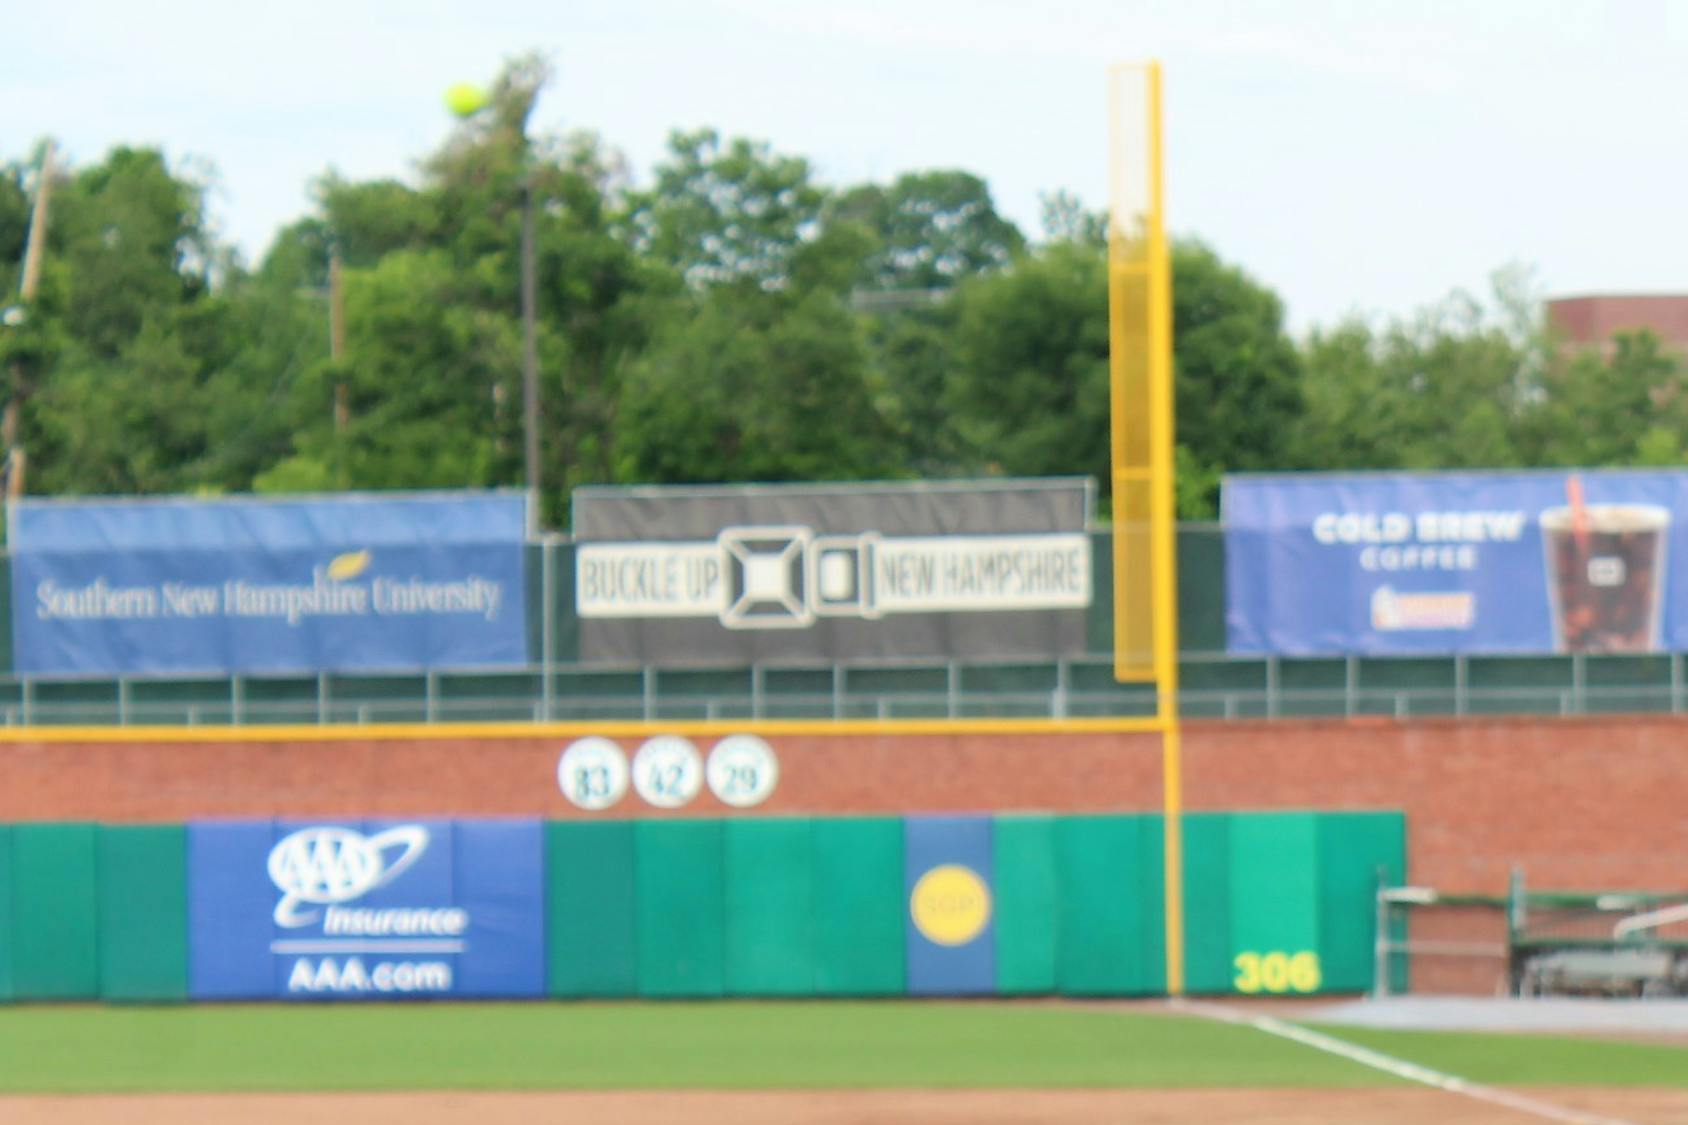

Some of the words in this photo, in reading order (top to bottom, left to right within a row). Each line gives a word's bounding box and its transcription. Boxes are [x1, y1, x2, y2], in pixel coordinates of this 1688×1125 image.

[1312, 513, 1411, 544] COLD
[1416, 511, 1525, 542] BREW
[584, 555, 680, 603] BUCKLE
[686, 555, 719, 602] UP
[879, 552, 937, 597] NEW
[944, 546, 1082, 597] HAMPSHIRE
[1359, 545, 1478, 571] COFFEE
[36, 575, 156, 620] Southern
[162, 580, 218, 618] New
[224, 564, 367, 626] Hampshire
[372, 574, 503, 621] University
[281, 836, 374, 892] AAA
[323, 906, 469, 936] Insurance
[288, 956, 452, 992] AAA.com
[1233, 950, 1322, 994] 306
